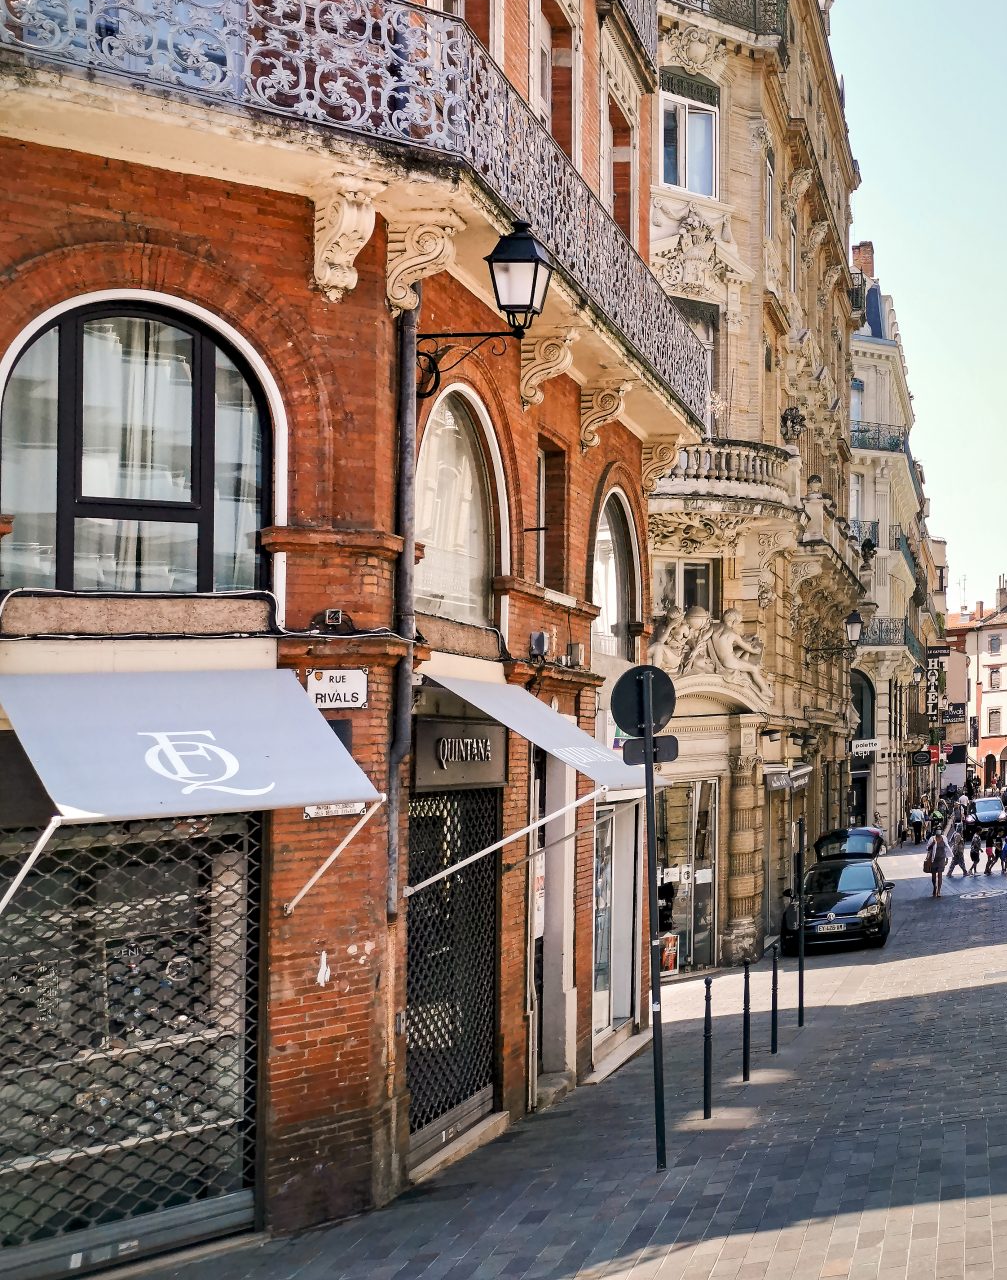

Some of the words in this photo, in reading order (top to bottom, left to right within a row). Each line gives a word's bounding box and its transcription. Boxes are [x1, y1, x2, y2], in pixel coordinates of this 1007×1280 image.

[328, 675, 347, 684] RUE
[315, 691, 360, 704] RIVALS
[440, 737, 492, 770] QUINTANA
